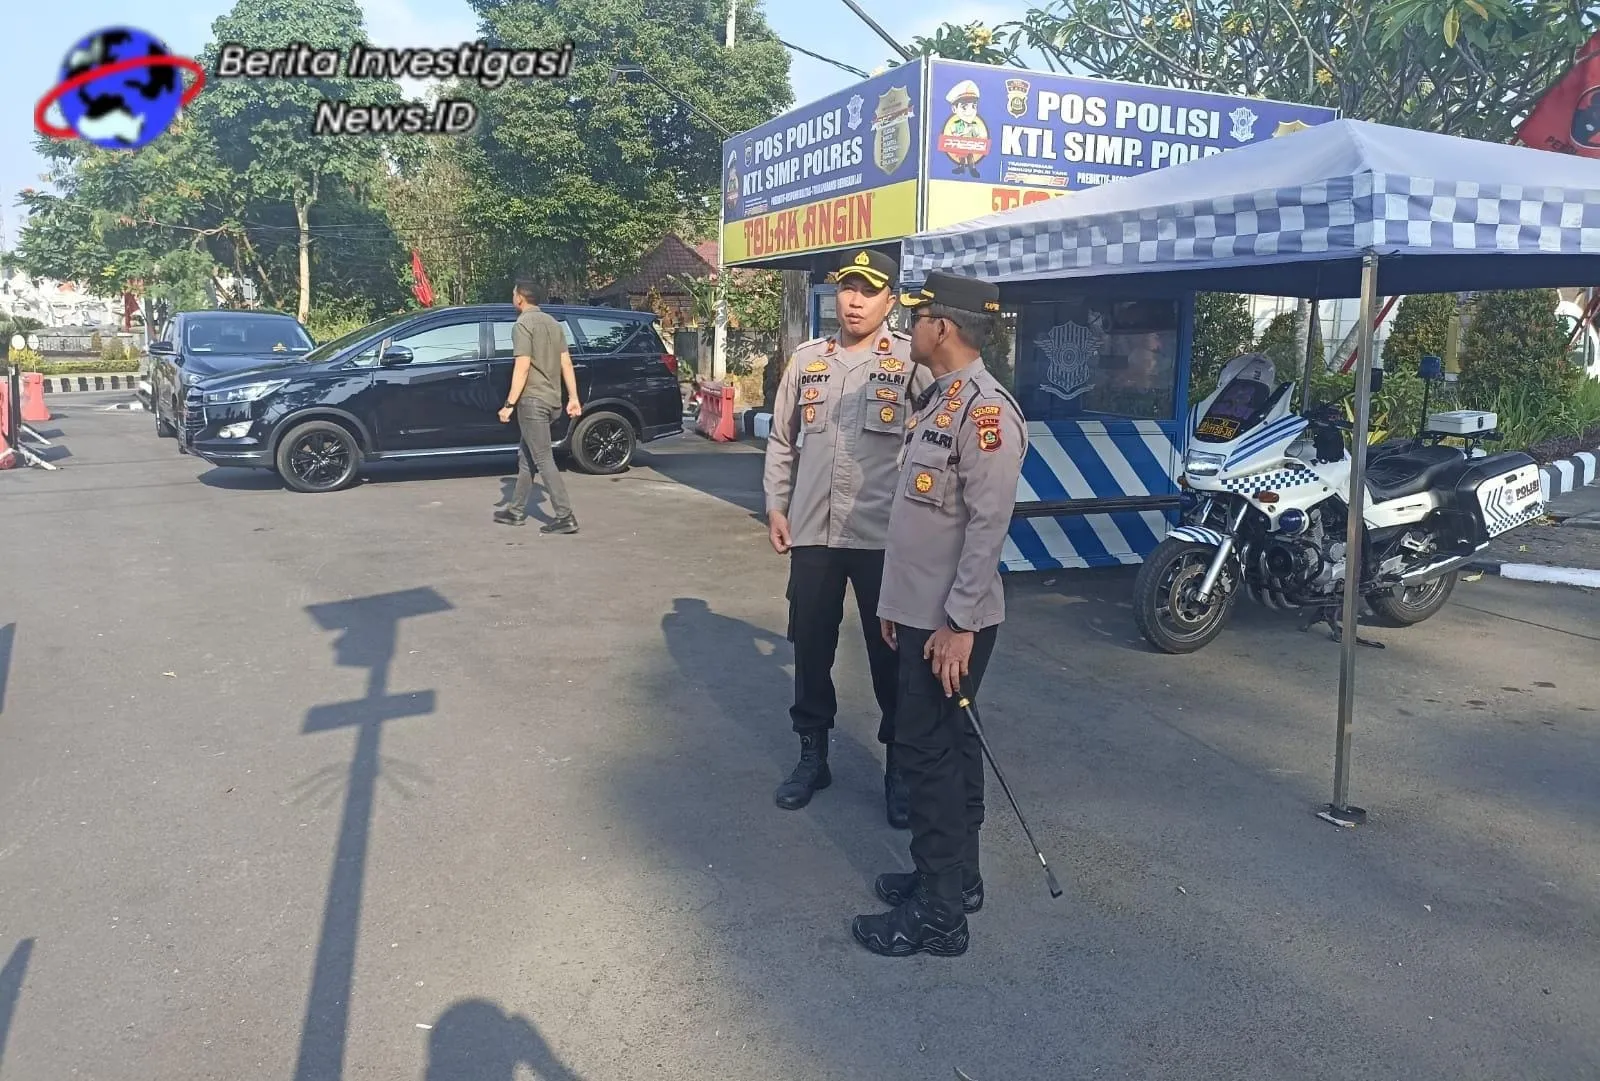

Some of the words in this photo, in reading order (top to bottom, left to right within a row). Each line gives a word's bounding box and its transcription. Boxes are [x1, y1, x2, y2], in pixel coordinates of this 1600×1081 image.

[755, 132, 782, 164] POS
[786, 108, 842, 152] POLISI
[1037, 91, 1107, 127] POS
[1115, 99, 1220, 139] POLISI
[742, 168, 764, 196] KTL
[766, 157, 801, 190] SIMP.
[803, 136, 863, 179] POLRES
[1001, 125, 1058, 160] KTL
[1064, 131, 1144, 169] SIMP.
[744, 209, 800, 256] TOLAK
[803, 192, 873, 247] ANGIN
[802, 374, 831, 385] DECKY
[869, 372, 905, 385] POLRI
[921, 429, 953, 448] POLRI
[1516, 479, 1539, 497] POLISI
